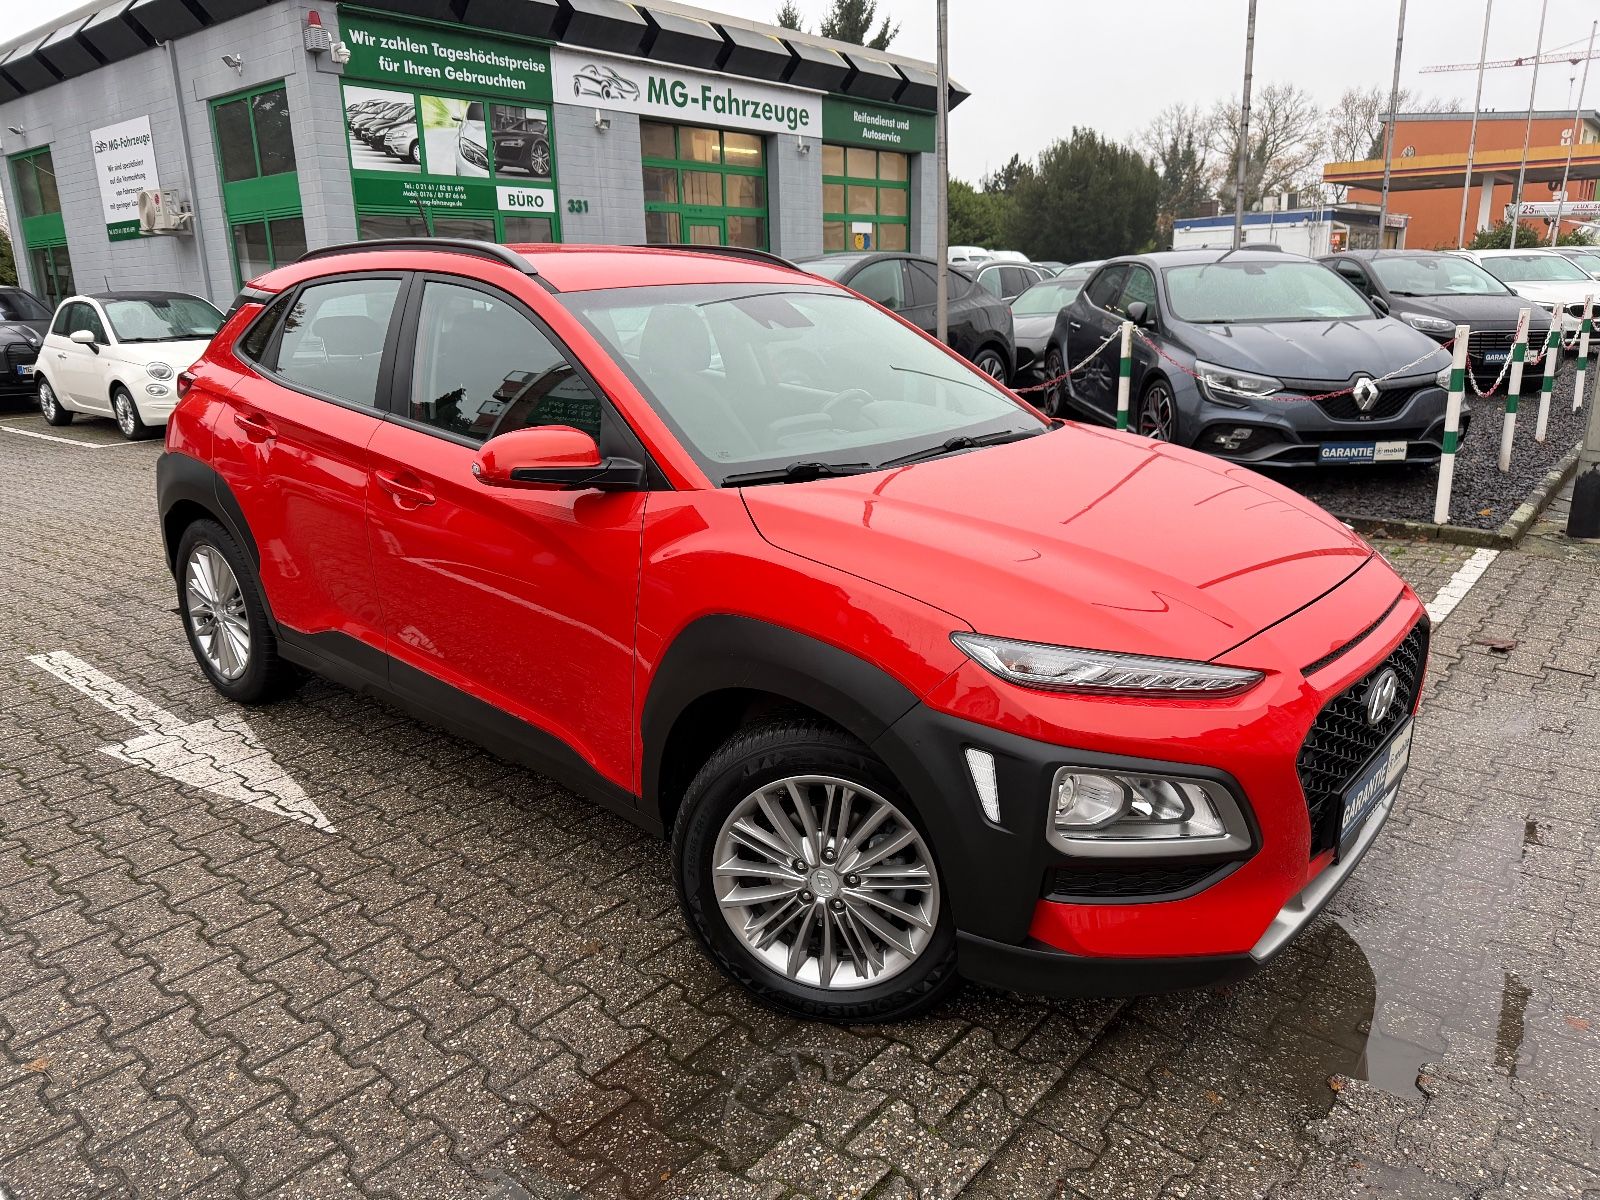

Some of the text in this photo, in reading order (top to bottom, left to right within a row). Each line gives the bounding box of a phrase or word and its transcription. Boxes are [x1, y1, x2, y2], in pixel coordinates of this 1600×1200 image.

[348, 28, 546, 73] Wir zahlen Tageshöchstpreise
[378, 56, 526, 90] für Ihren Gebrauchten
[647, 76, 810, 130] MG-Fahrzeuge
[853, 111, 909, 130] Reifendienst und
[108, 134, 150, 151] MG-Fahrzeuge
[862, 128, 901, 144] Autoservice
[508, 191, 544, 208] BÜRO
[568, 199, 588, 214] 331
[1322, 447, 1374, 457] GARANTIE
[1342, 760, 1388, 828] GARANTIE
